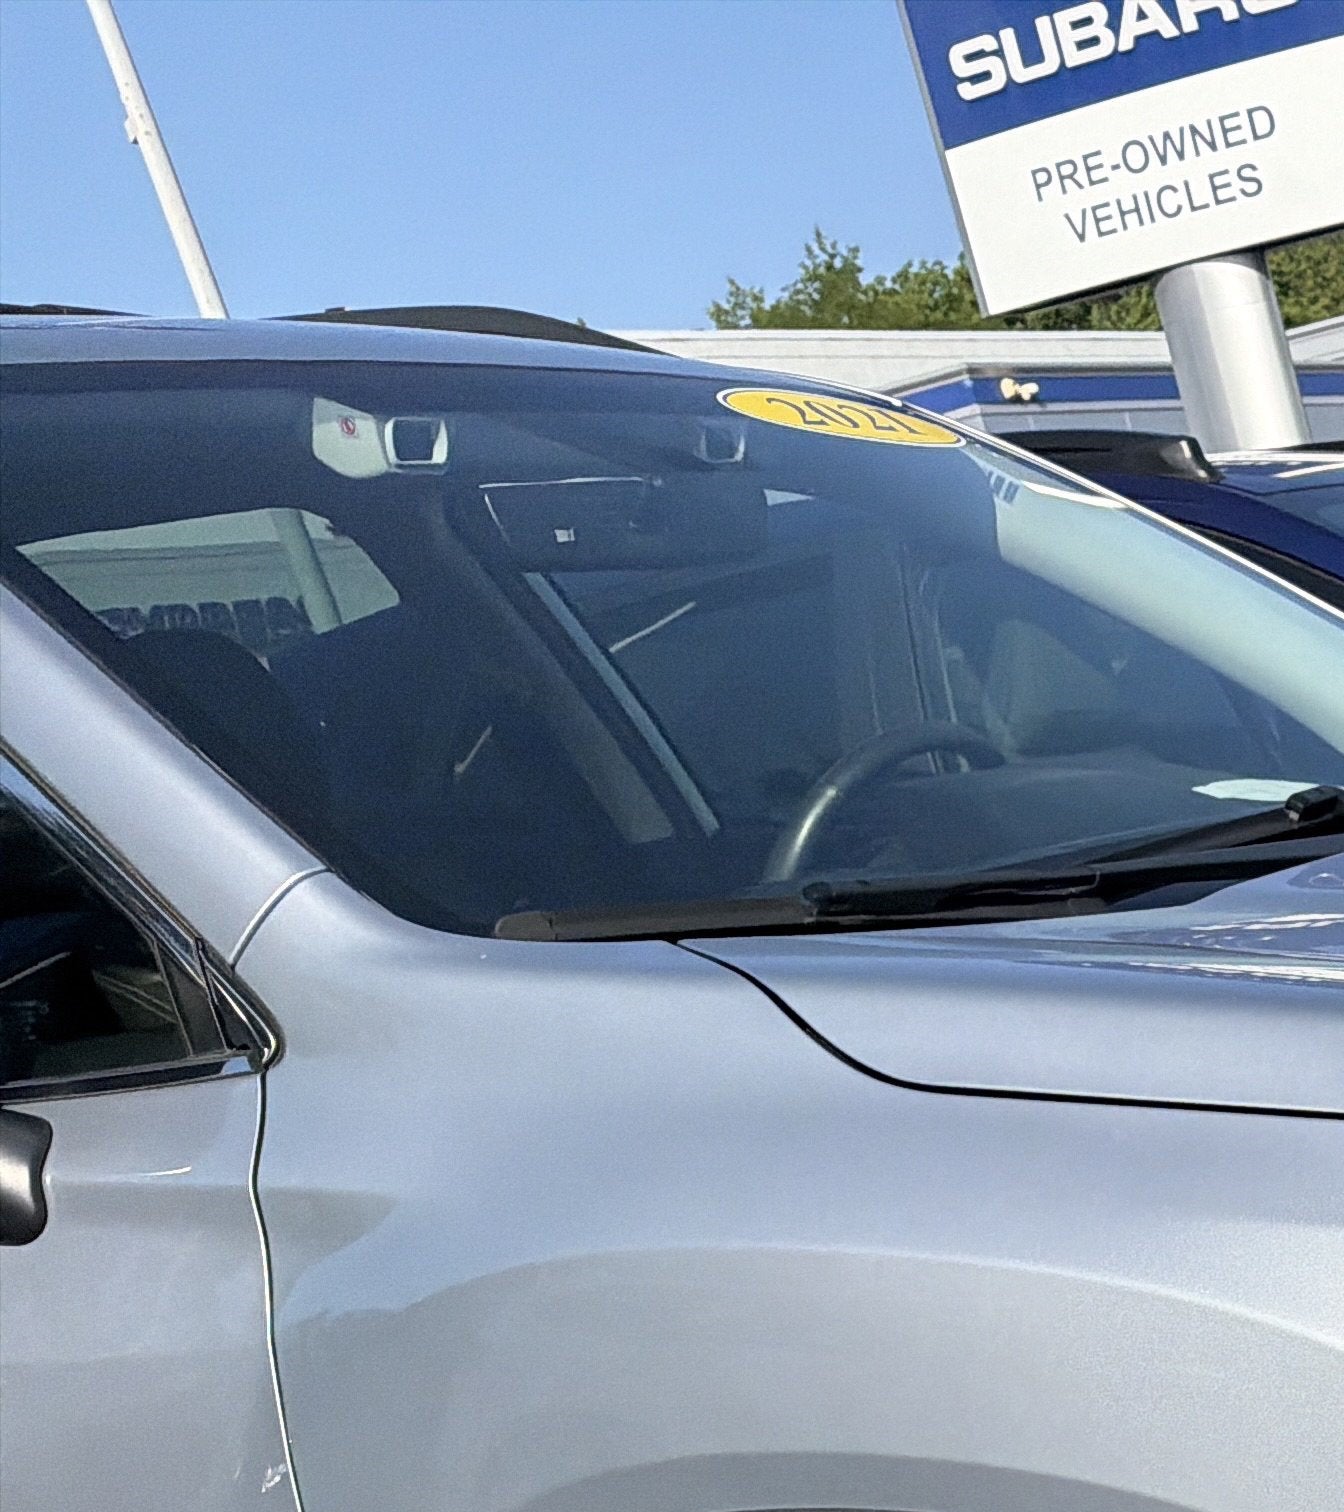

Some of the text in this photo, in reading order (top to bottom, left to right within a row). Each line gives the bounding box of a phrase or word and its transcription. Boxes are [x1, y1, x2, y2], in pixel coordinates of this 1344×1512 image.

[948, 0, 1297, 101] SUBA
[1030, 105, 1276, 202] PRE-OWNED
[1064, 163, 1264, 243] VEHICLES
[765, 397, 923, 435] 2021
